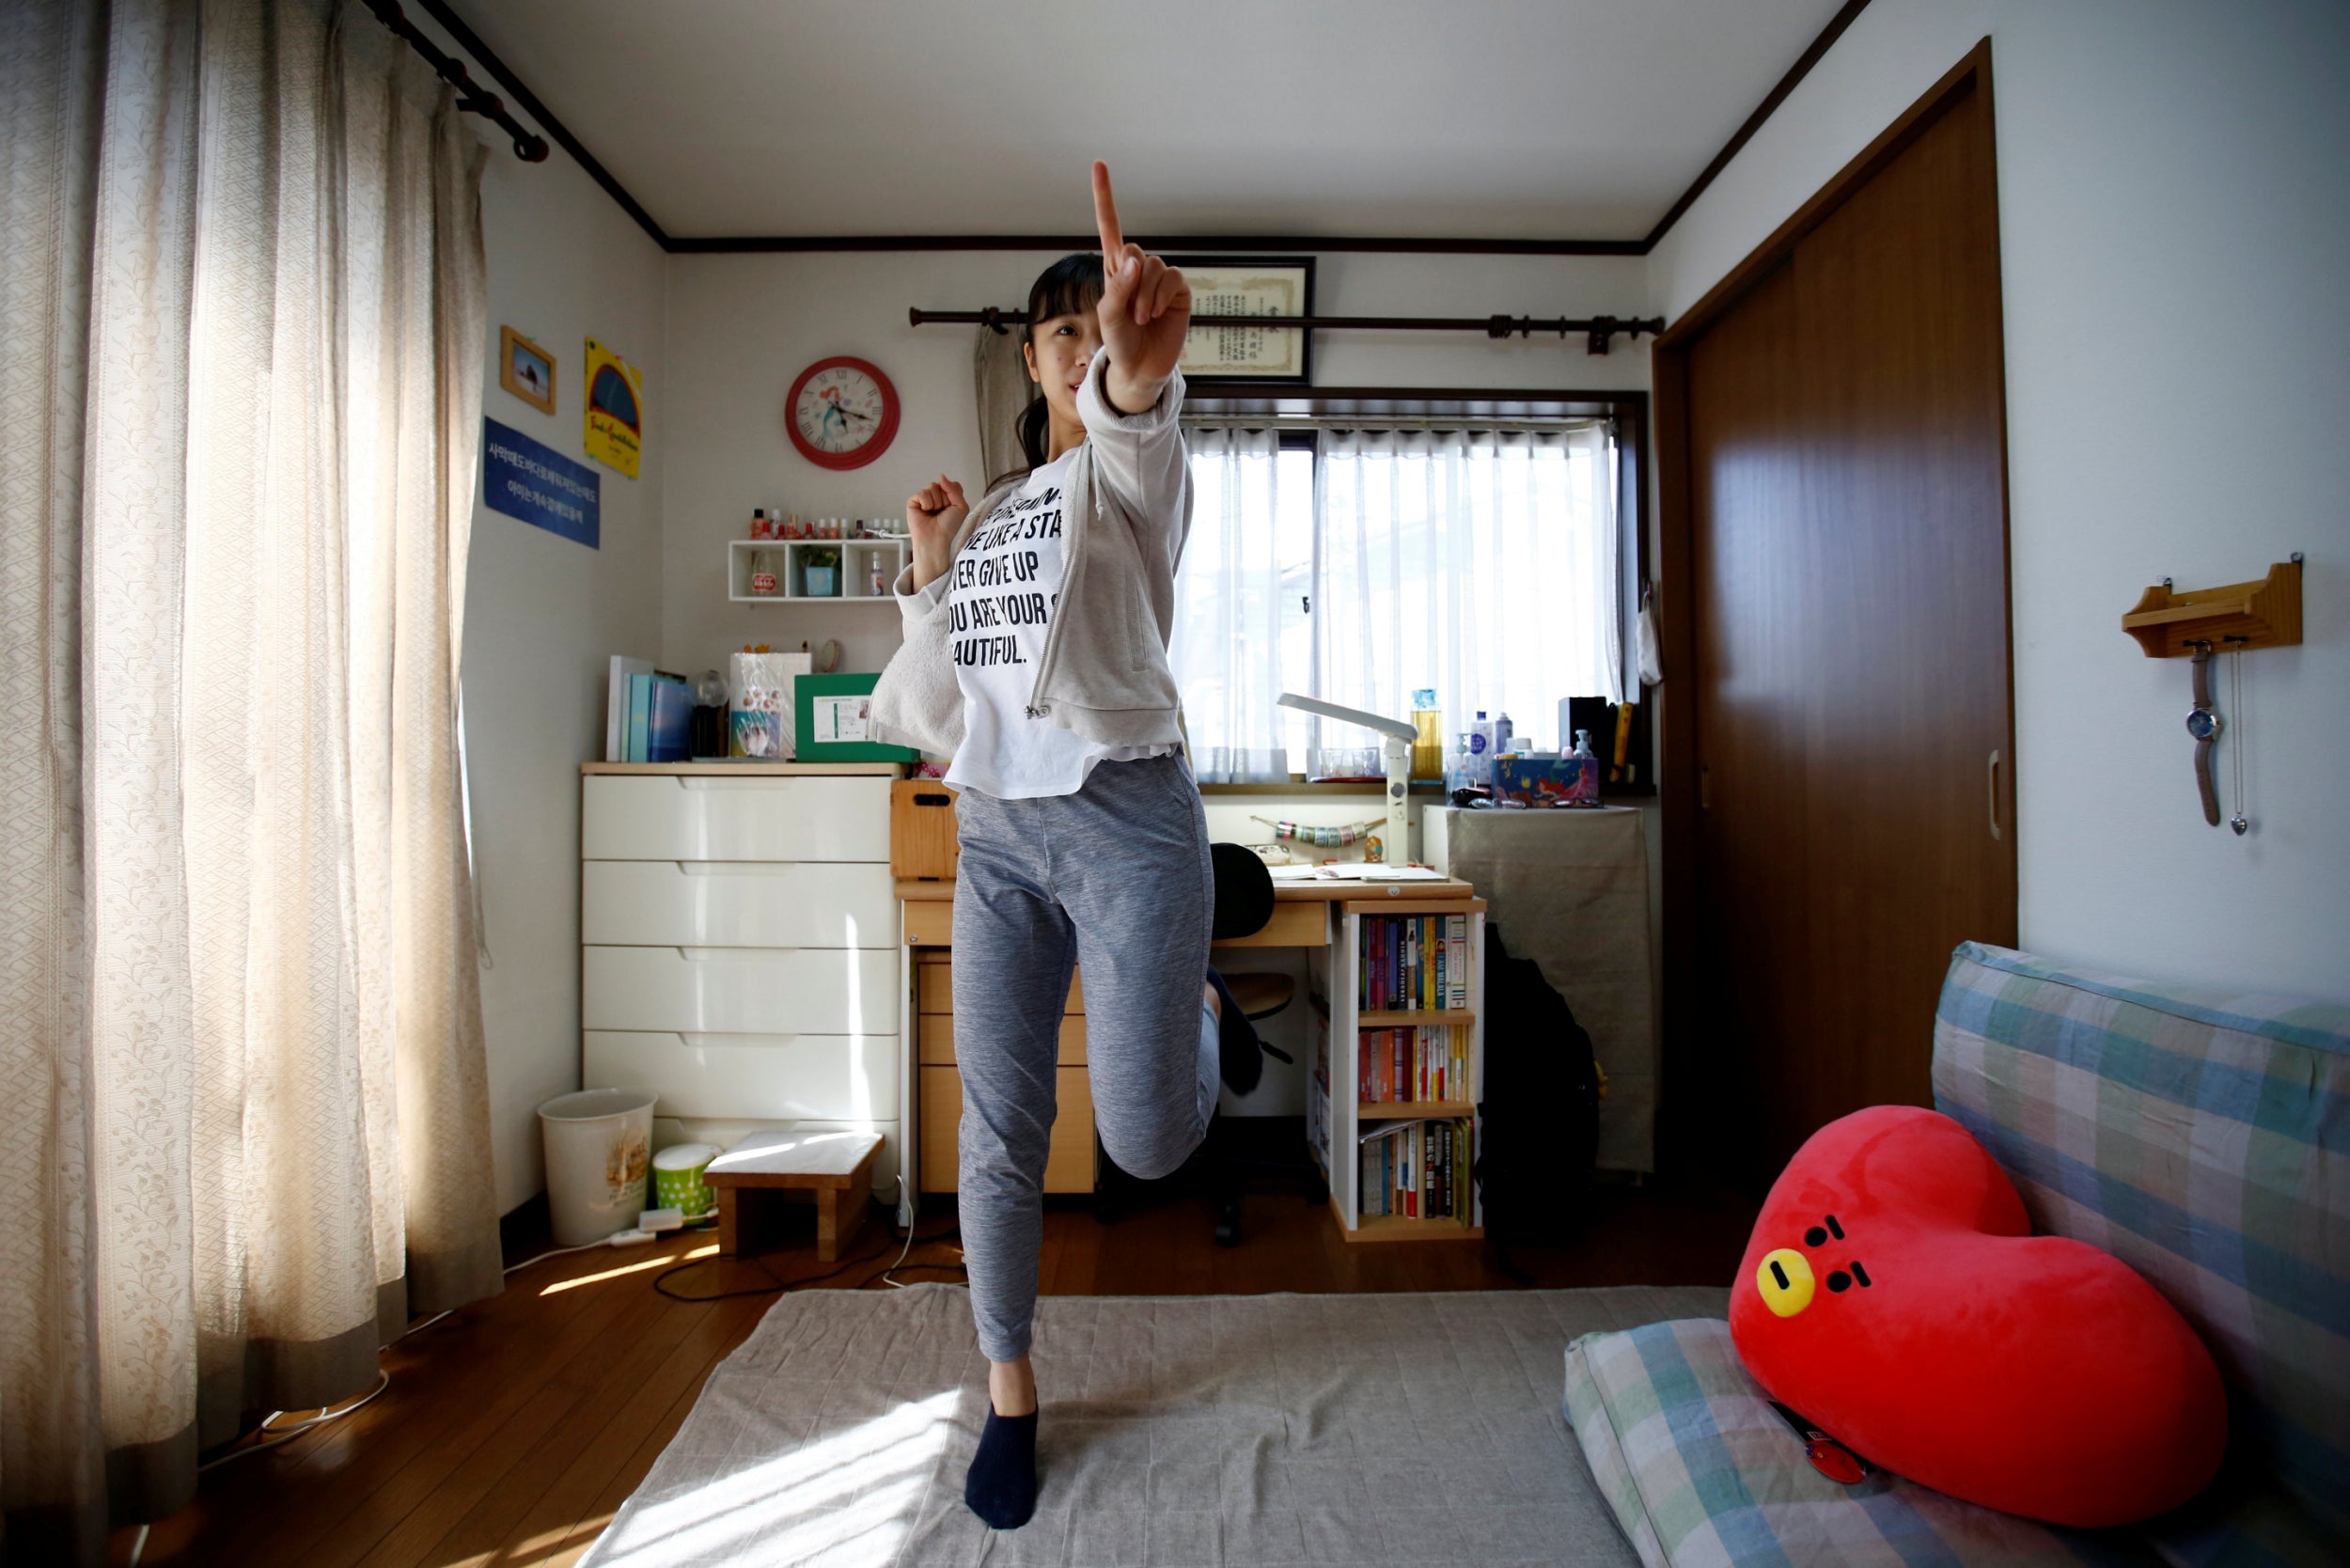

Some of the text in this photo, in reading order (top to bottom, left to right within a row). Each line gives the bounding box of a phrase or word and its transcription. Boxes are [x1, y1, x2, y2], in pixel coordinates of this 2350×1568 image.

[983, 523, 1017, 551] LIKE
[1010, 518, 1025, 542] A
[950, 551, 1038, 593] VER GIVE UP
[971, 598, 1001, 630] ARE
[996, 593, 1047, 625] YOUR
